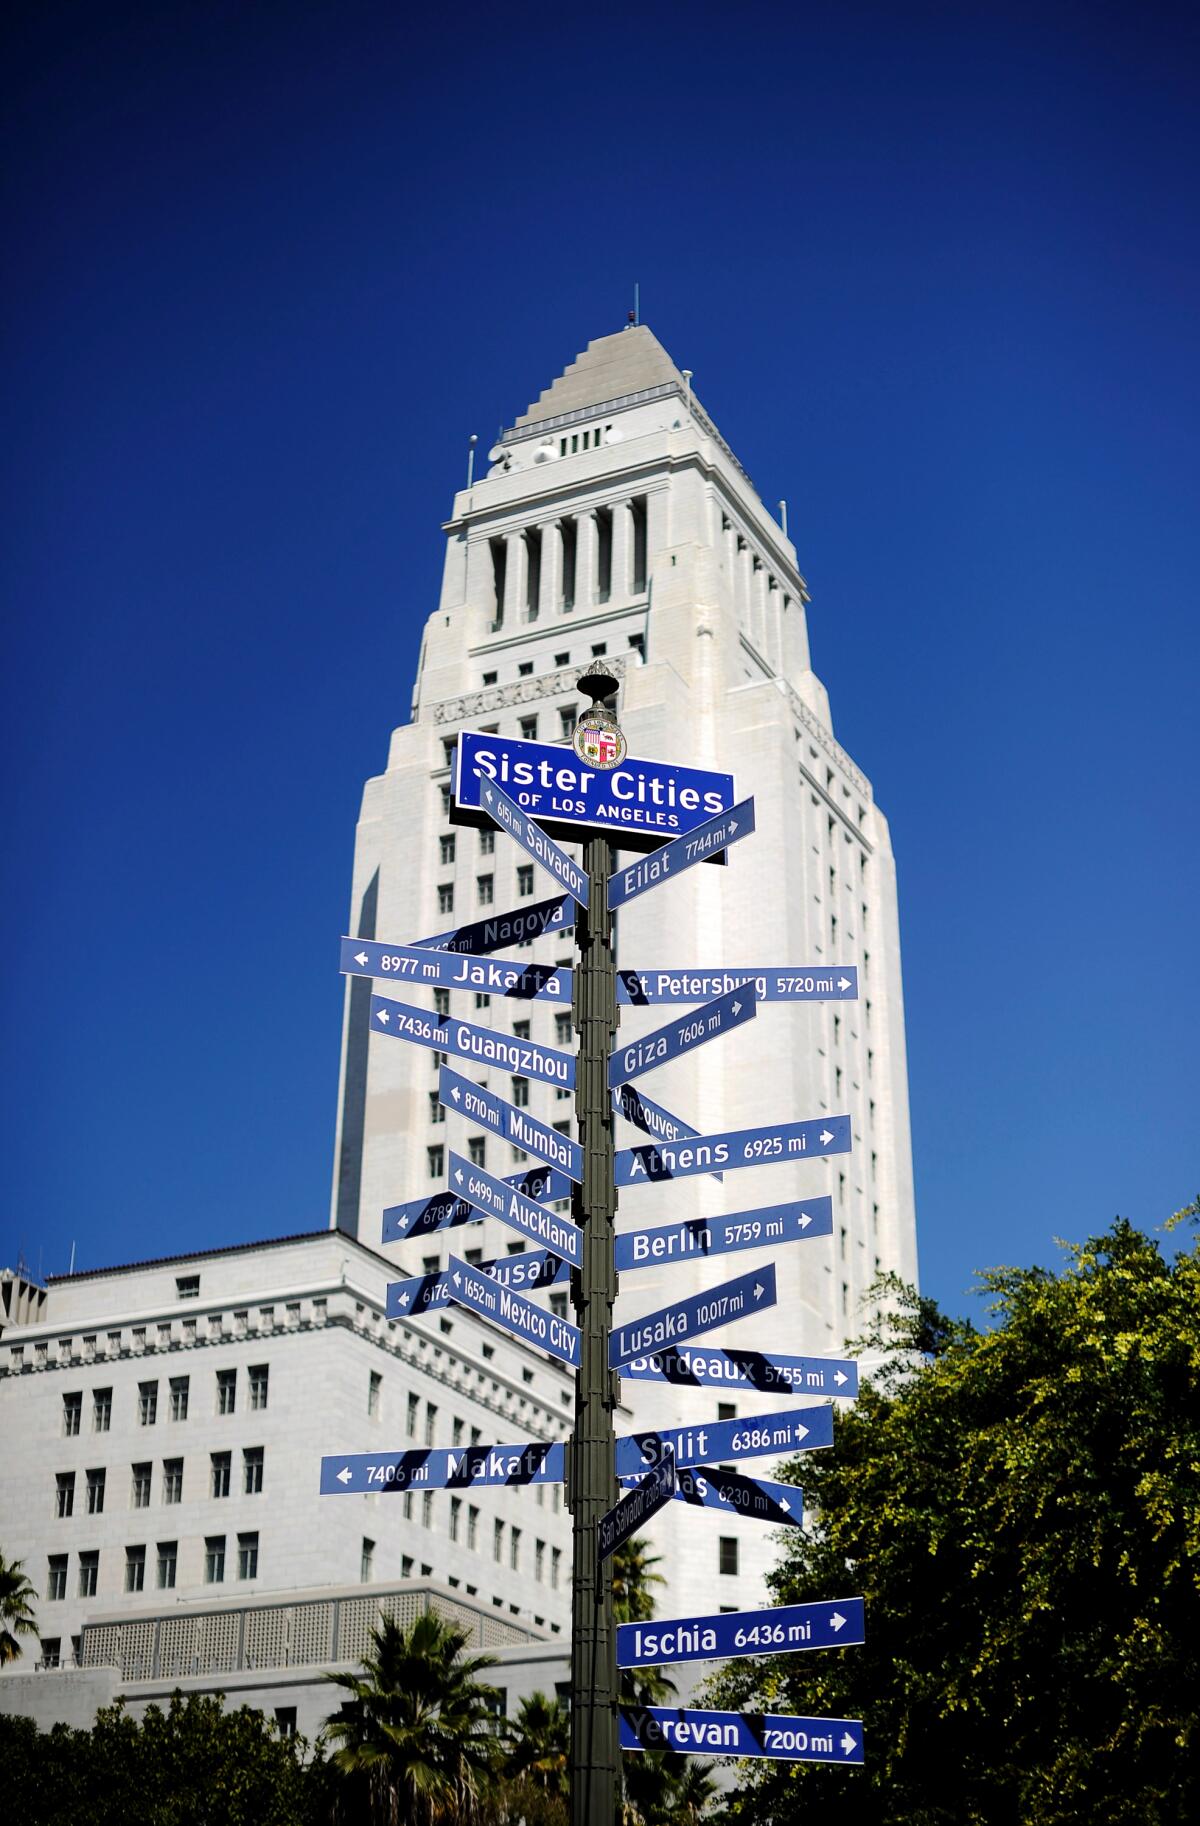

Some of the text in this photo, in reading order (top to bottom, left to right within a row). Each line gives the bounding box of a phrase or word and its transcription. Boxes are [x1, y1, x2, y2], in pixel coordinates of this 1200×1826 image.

[473, 751, 723, 812] Sister Cities
[519, 793, 542, 806] OF
[552, 797, 585, 813] LOS
[596, 805, 678, 827] ANGELES
[498, 802, 583, 893] 6151 mi Salvador
[624, 827, 726, 895] Eilat 7744 mi
[484, 906, 563, 944] Nagoya
[382, 955, 560, 995] 8977 mi Jakarta
[777, 977, 813, 993] 5720
[817, 977, 833, 992] mi
[398, 1015, 568, 1080] 7436 mi Guangzhou
[624, 1010, 721, 1073] Giza 7606 mi
[465, 1093, 572, 1168] 8710 mi Mumbai
[615, 1086, 678, 1140] Vancouver
[630, 1134, 806, 1177] Athens 6925 mi
[424, 1203, 452, 1224] 6789
[469, 1177, 492, 1202] 6499
[494, 1195, 504, 1212] mi
[509, 1195, 576, 1255] Auckland
[633, 1218, 783, 1260] Berlin 5759 mi
[423, 1283, 449, 1302] 6176
[464, 1278, 576, 1359] 1652 mi Mexico City
[620, 1292, 744, 1357] Lusaka 10,017 mi
[765, 1366, 802, 1384] 5755
[807, 1371, 824, 1386] mi
[732, 1428, 770, 1451] 6386
[774, 1426, 791, 1445] mi
[366, 1450, 546, 1484] 7406 mi Makati
[602, 1520, 614, 1549] San
[616, 1490, 644, 1536] Salvador
[719, 1486, 768, 1511] 6230 mi
[635, 1621, 811, 1658] Ischia 6436 mi
[629, 1713, 832, 1753] Yerevan 7200 mi
